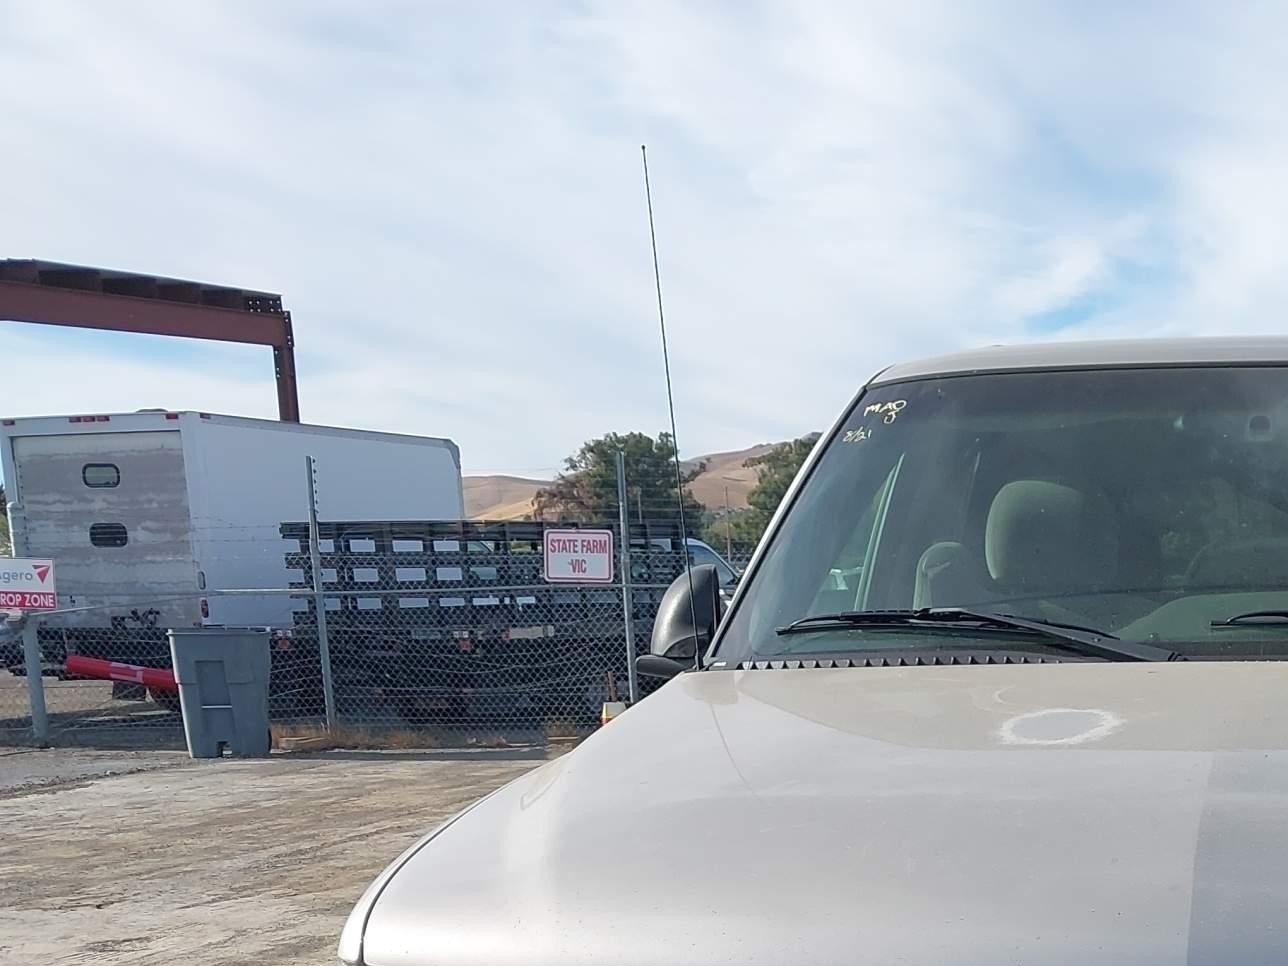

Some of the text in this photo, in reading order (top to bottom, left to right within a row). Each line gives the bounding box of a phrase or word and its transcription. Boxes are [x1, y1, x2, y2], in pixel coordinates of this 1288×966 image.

[549, 539, 608, 554] STATE FARM
[570, 559, 587, 574] VIC
[0, 571, 33, 583] gero
[0, 593, 54, 607] ROP ZONE
